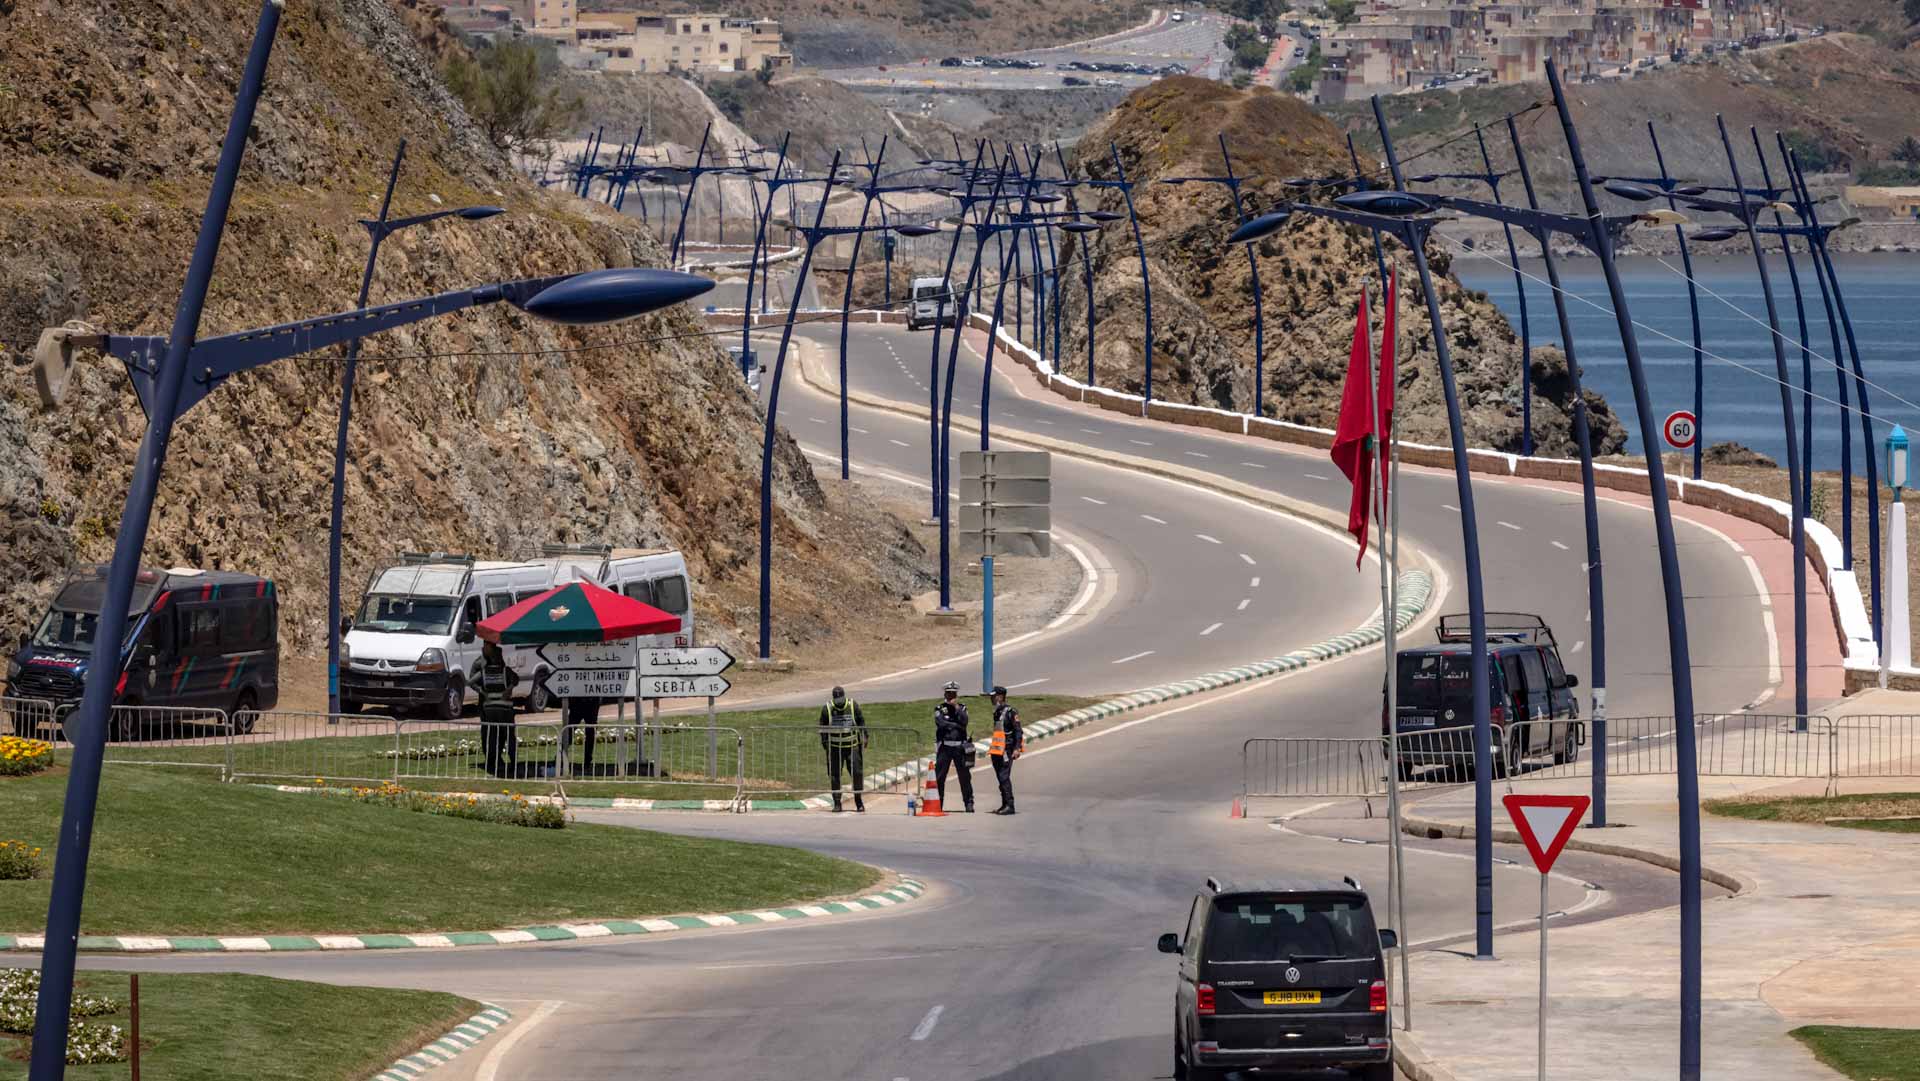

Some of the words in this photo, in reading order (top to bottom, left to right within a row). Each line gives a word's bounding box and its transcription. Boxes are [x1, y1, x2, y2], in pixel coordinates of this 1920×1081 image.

[1673, 423, 1690, 437] 60
[557, 654, 570, 662] 65
[584, 651, 622, 665] طنجة
[650, 652, 698, 671] سبتة
[708, 657, 719, 665] 15
[557, 673, 570, 682] 20
[575, 671, 591, 681] PORT
[592, 671, 616, 681] TANGER
[584, 684, 623, 694] TANGER
[654, 681, 696, 693] SEBTA
[708, 683, 720, 692] 15
[1270, 992, 1293, 1002] GJ18
[1295, 992, 1315, 1001] UXM
